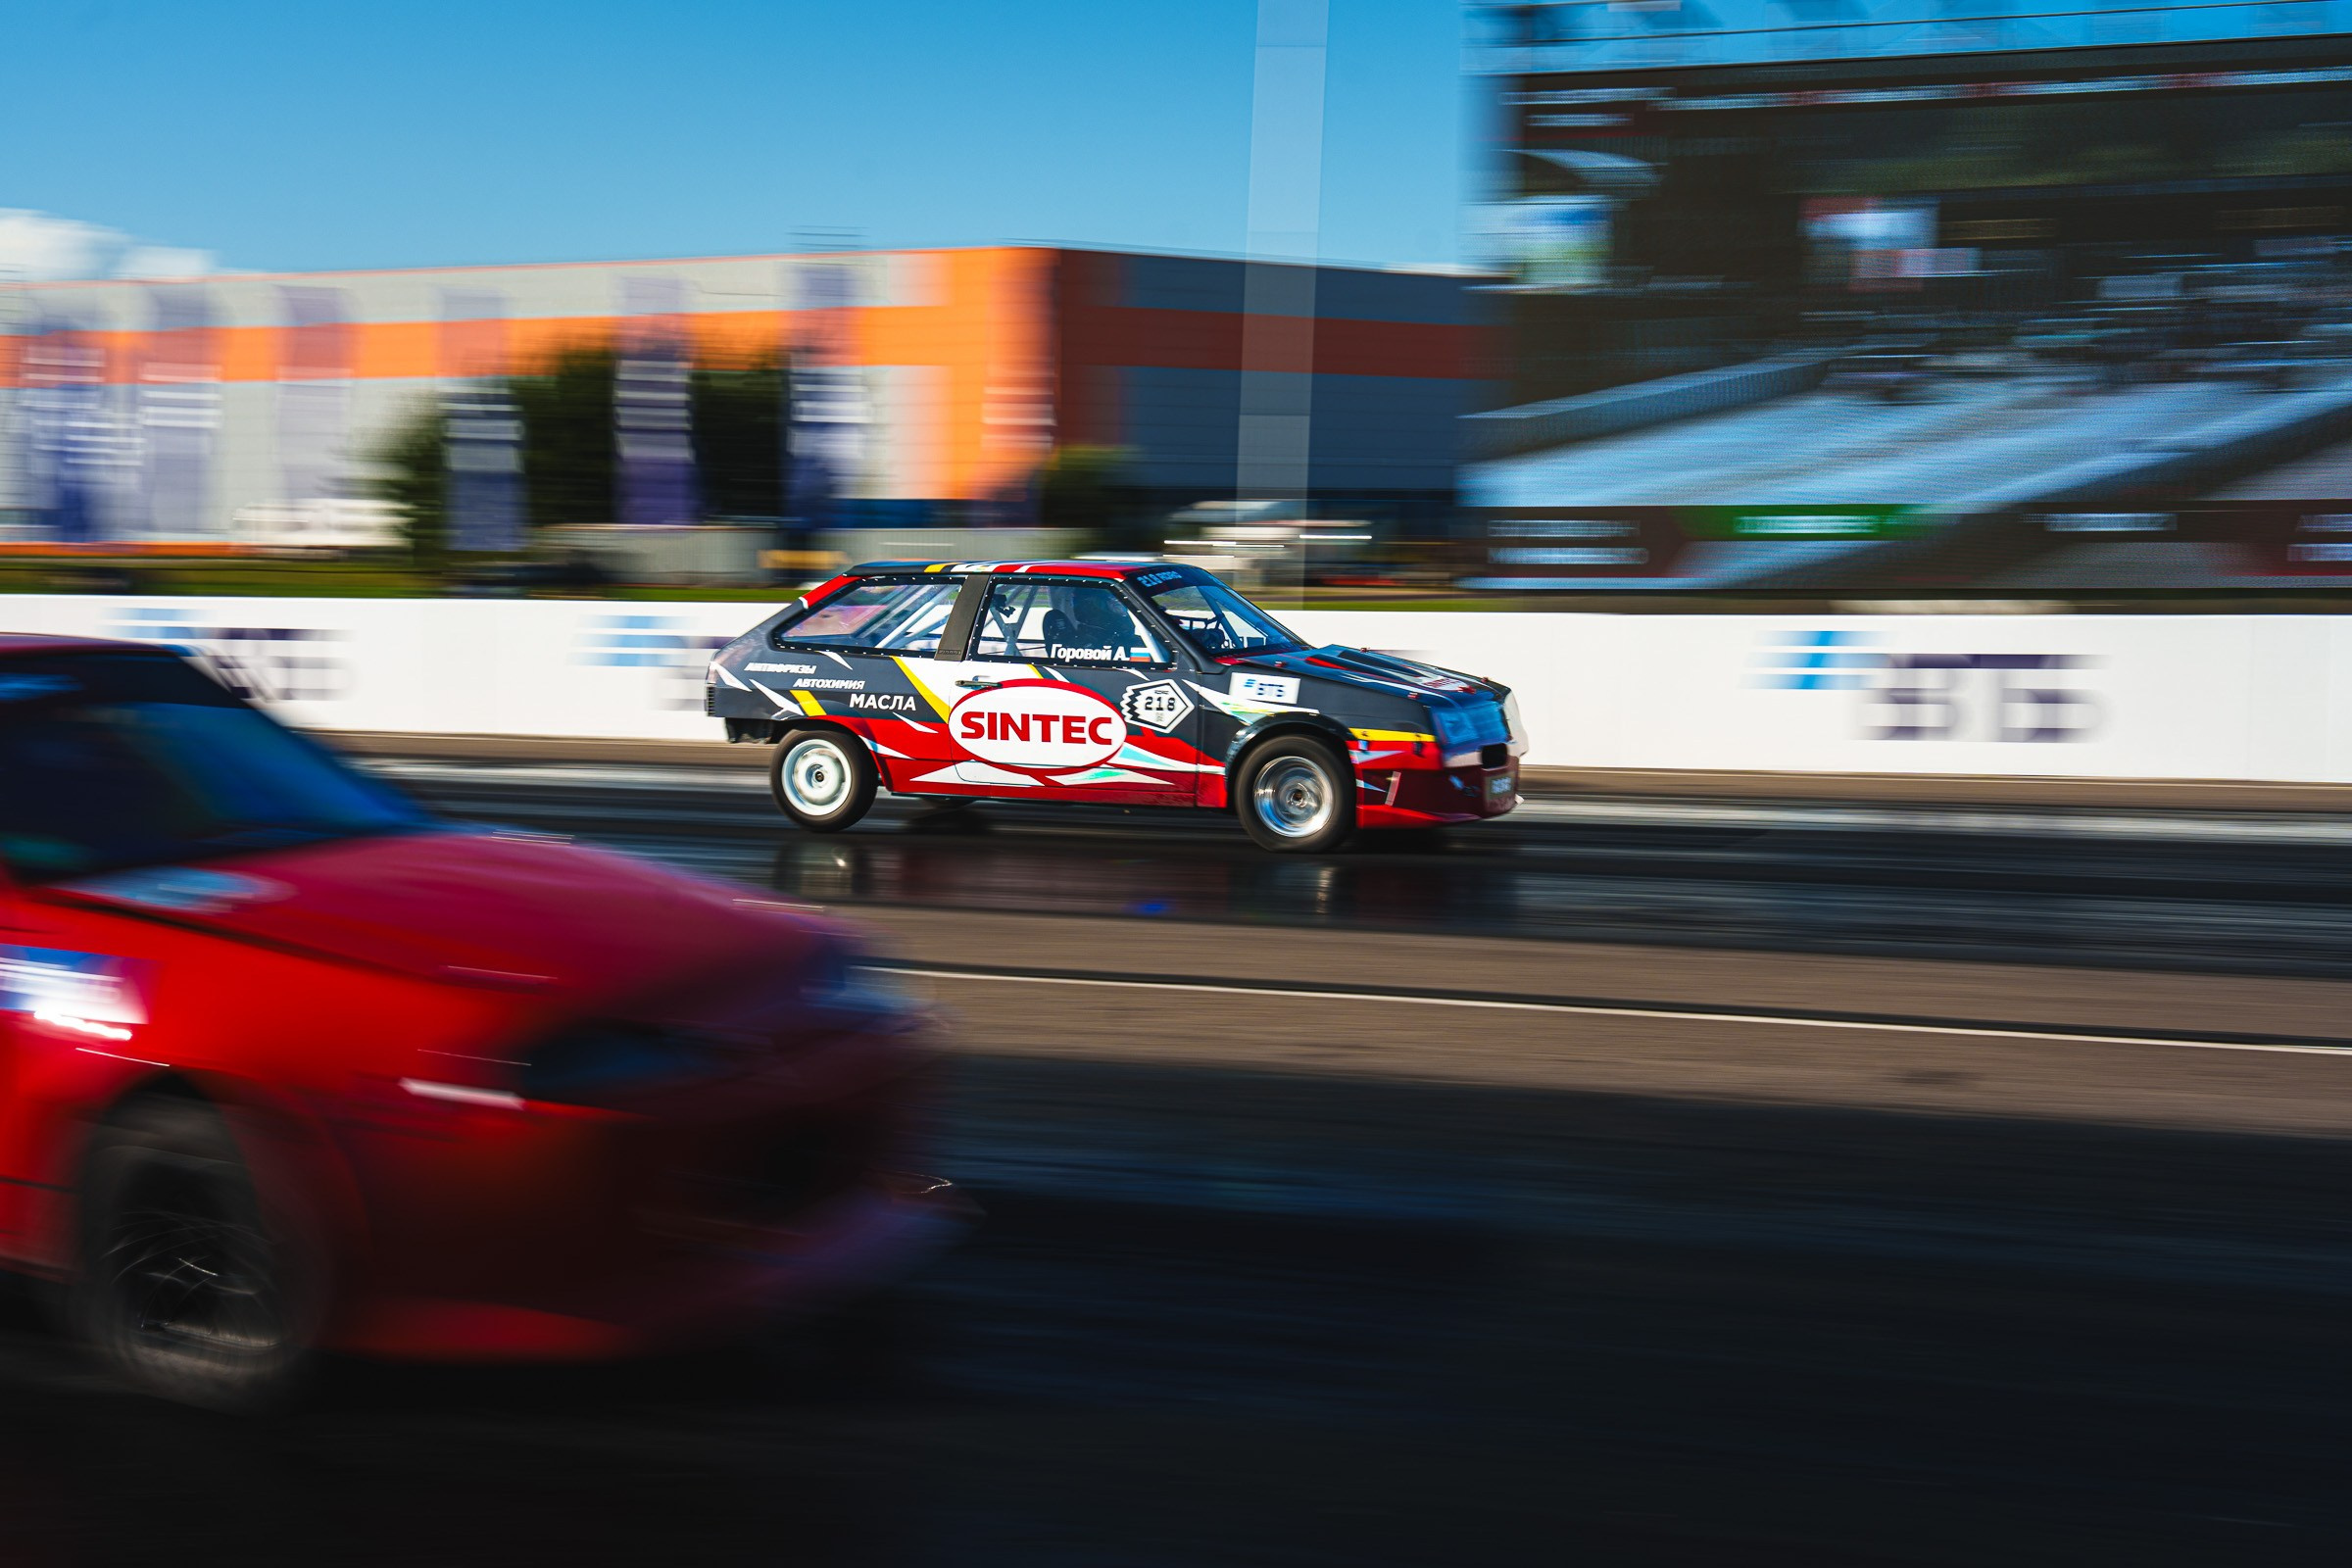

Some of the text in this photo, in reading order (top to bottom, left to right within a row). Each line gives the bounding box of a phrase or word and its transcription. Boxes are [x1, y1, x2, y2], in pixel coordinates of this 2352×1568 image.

[1050, 643, 1130, 662] Горовой А.
[793, 678, 866, 690] АВТОХИМИЯ
[849, 693, 917, 711] МАСЛА
[1145, 696, 1176, 711] 218
[960, 710, 1112, 745] SINTEC
